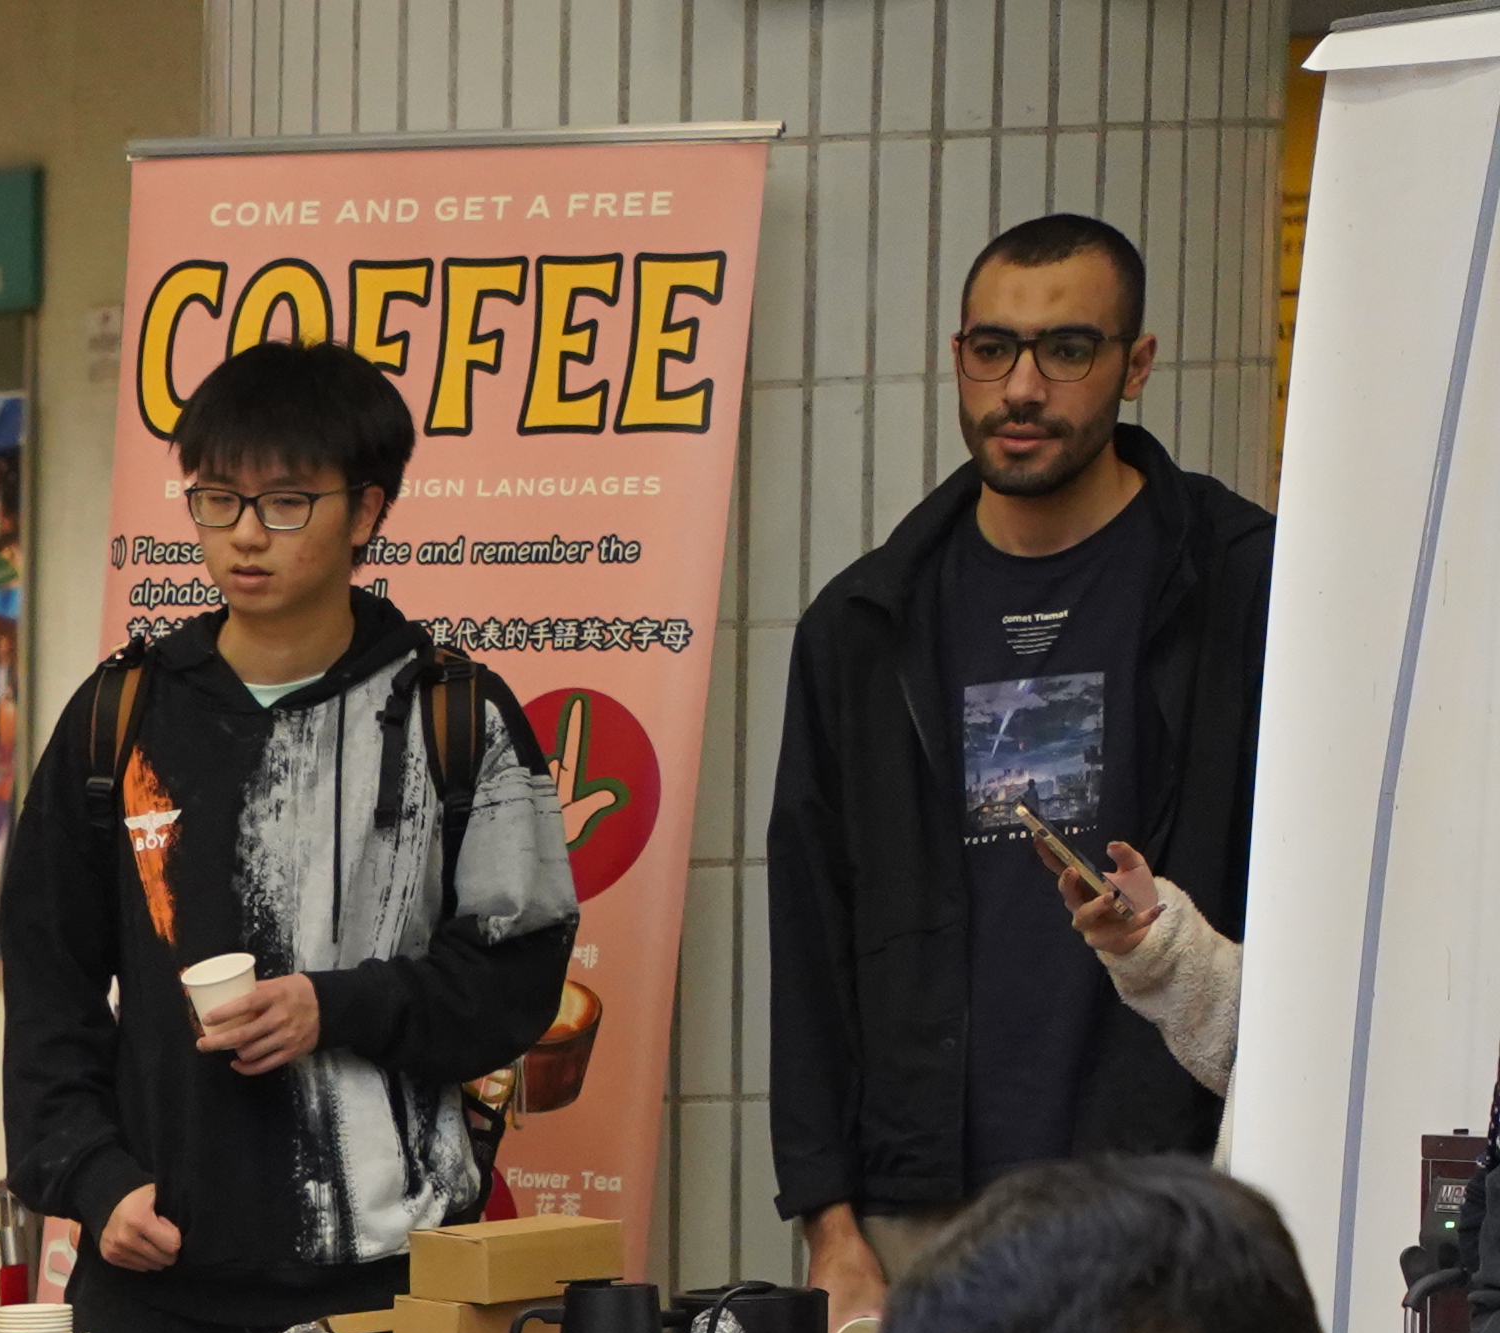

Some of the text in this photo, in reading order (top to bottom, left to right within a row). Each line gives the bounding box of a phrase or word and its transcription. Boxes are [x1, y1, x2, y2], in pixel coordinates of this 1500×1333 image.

[210, 191, 674, 227] COME AND GET A FREE
[477, 475, 663, 499] LANGUAGES
[133, 536, 640, 565] Please and remember the
[1002, 614, 1032, 624] Comet
[134, 833, 168, 853] BOY
[507, 1167, 622, 1192] Flower Tea
